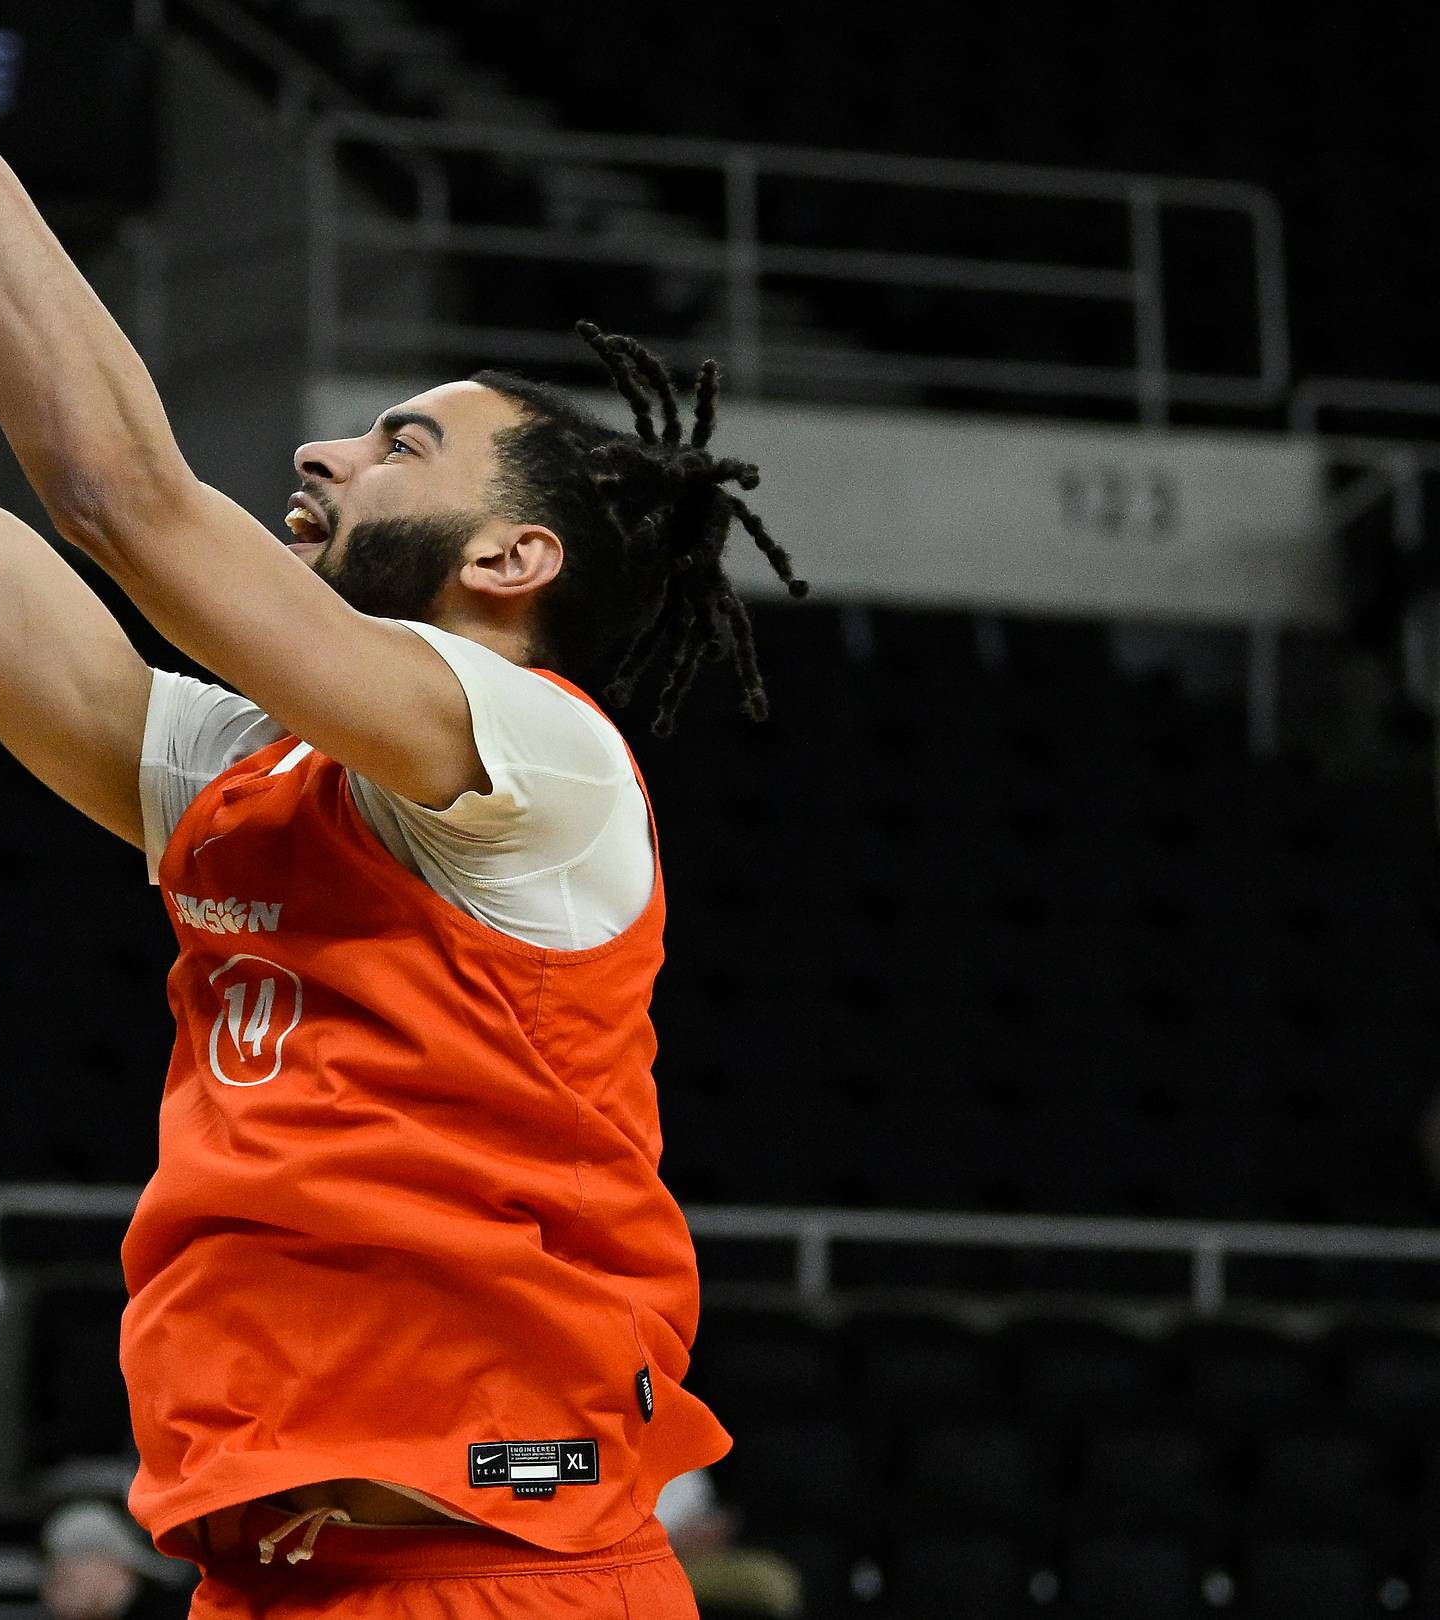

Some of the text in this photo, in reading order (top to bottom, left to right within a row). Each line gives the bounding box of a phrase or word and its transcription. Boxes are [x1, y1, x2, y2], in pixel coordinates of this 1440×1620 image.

[223, 977, 276, 1062] 14
[641, 1376, 653, 1411] MENS
[476, 1468, 505, 1476] TEAM
[566, 1453, 589, 1470] XL
